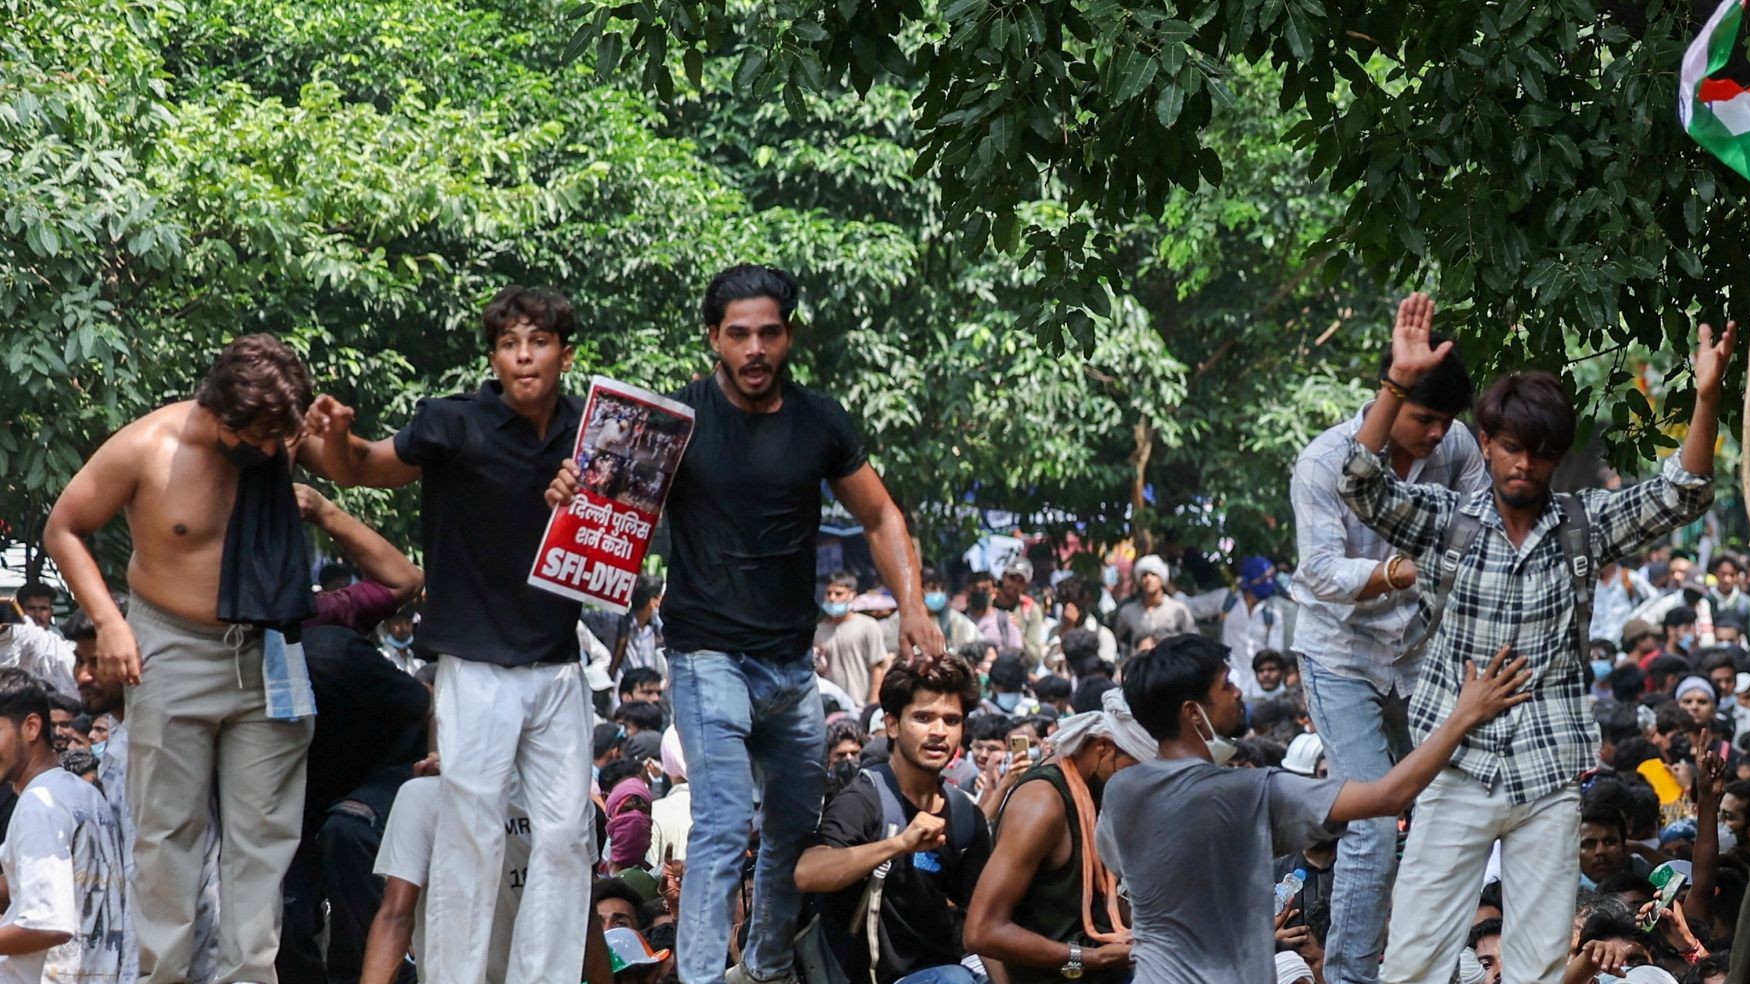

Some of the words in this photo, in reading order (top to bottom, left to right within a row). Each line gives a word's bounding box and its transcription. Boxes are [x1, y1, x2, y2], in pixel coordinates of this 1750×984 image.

[568, 493, 613, 527] दिल्ली
[612, 511, 652, 540] पुलिस
[575, 526, 606, 549] शर्म
[541, 547, 637, 602] SFI-DYFI
